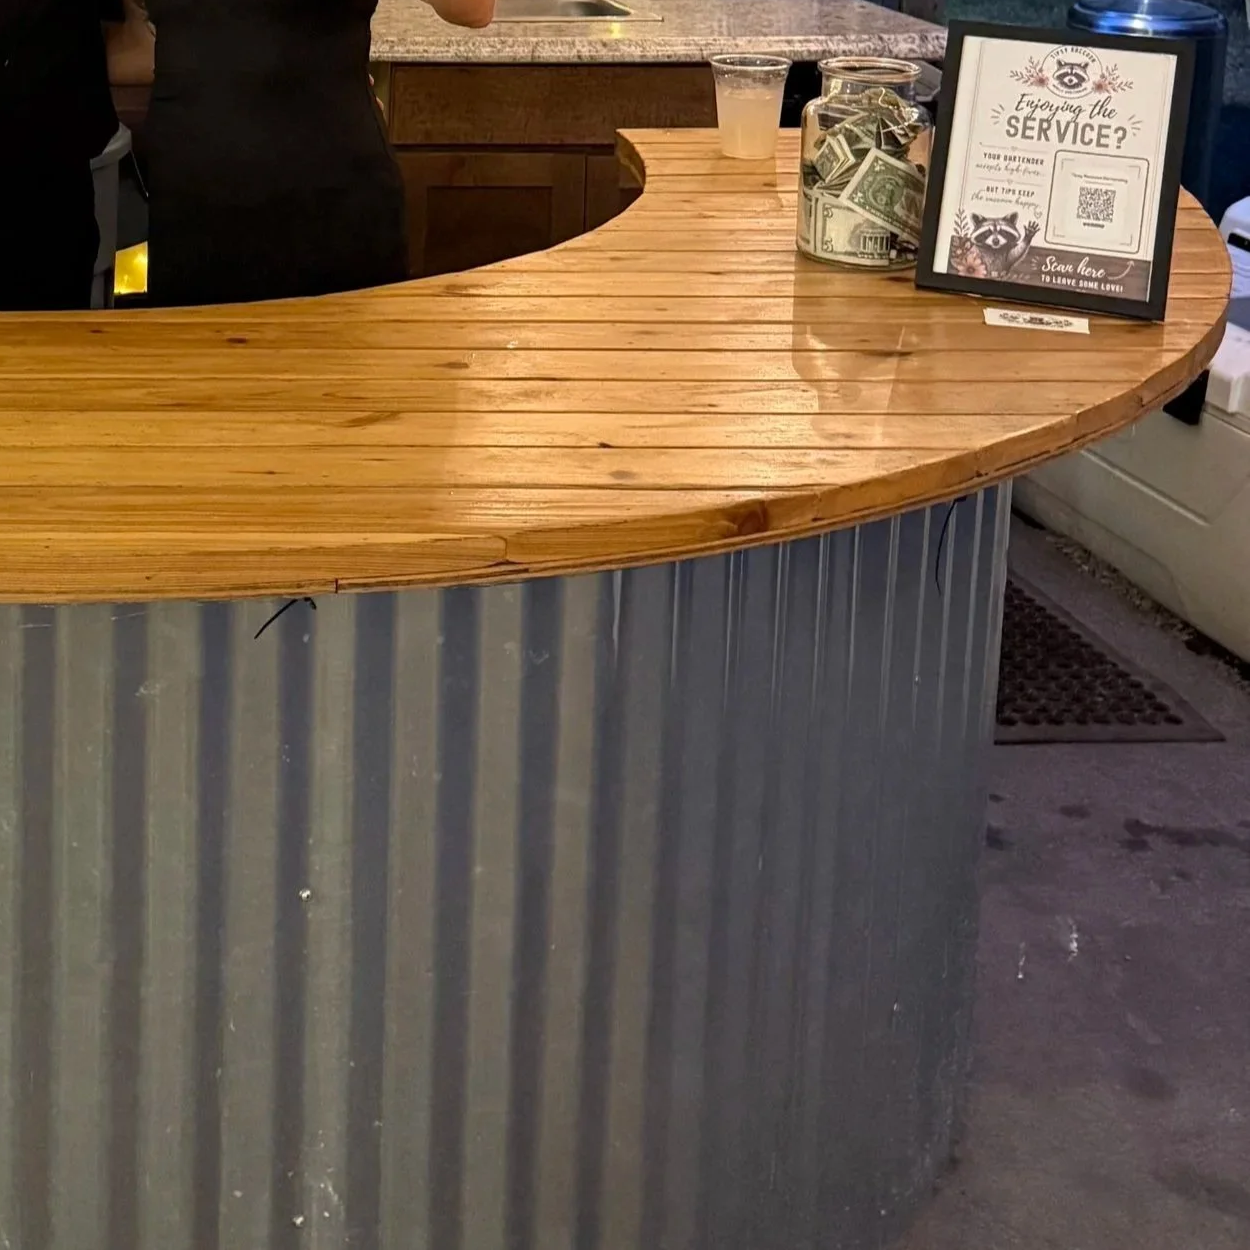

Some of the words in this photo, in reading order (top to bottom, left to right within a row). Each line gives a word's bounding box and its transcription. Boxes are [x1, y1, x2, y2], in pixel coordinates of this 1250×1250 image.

[1071, 47, 1096, 63] RACCOON
[1015, 93, 1086, 123] Enjoying
[1089, 95, 1118, 120] the
[1005, 115, 1128, 149] SERVICE?
[983, 152, 1001, 160] YOUR
[1004, 154, 1044, 165] BARTENDER
[986, 186, 999, 194] BUT
[1002, 187, 1016, 195] TIPS
[1041, 255, 1074, 273] Scan
[1077, 256, 1106, 278] here
[1041, 274, 1051, 282] TO
[1052, 276, 1076, 286] LEAVE
[1079, 280, 1099, 290] SOME
[1101, 282, 1124, 293] LOVE!
